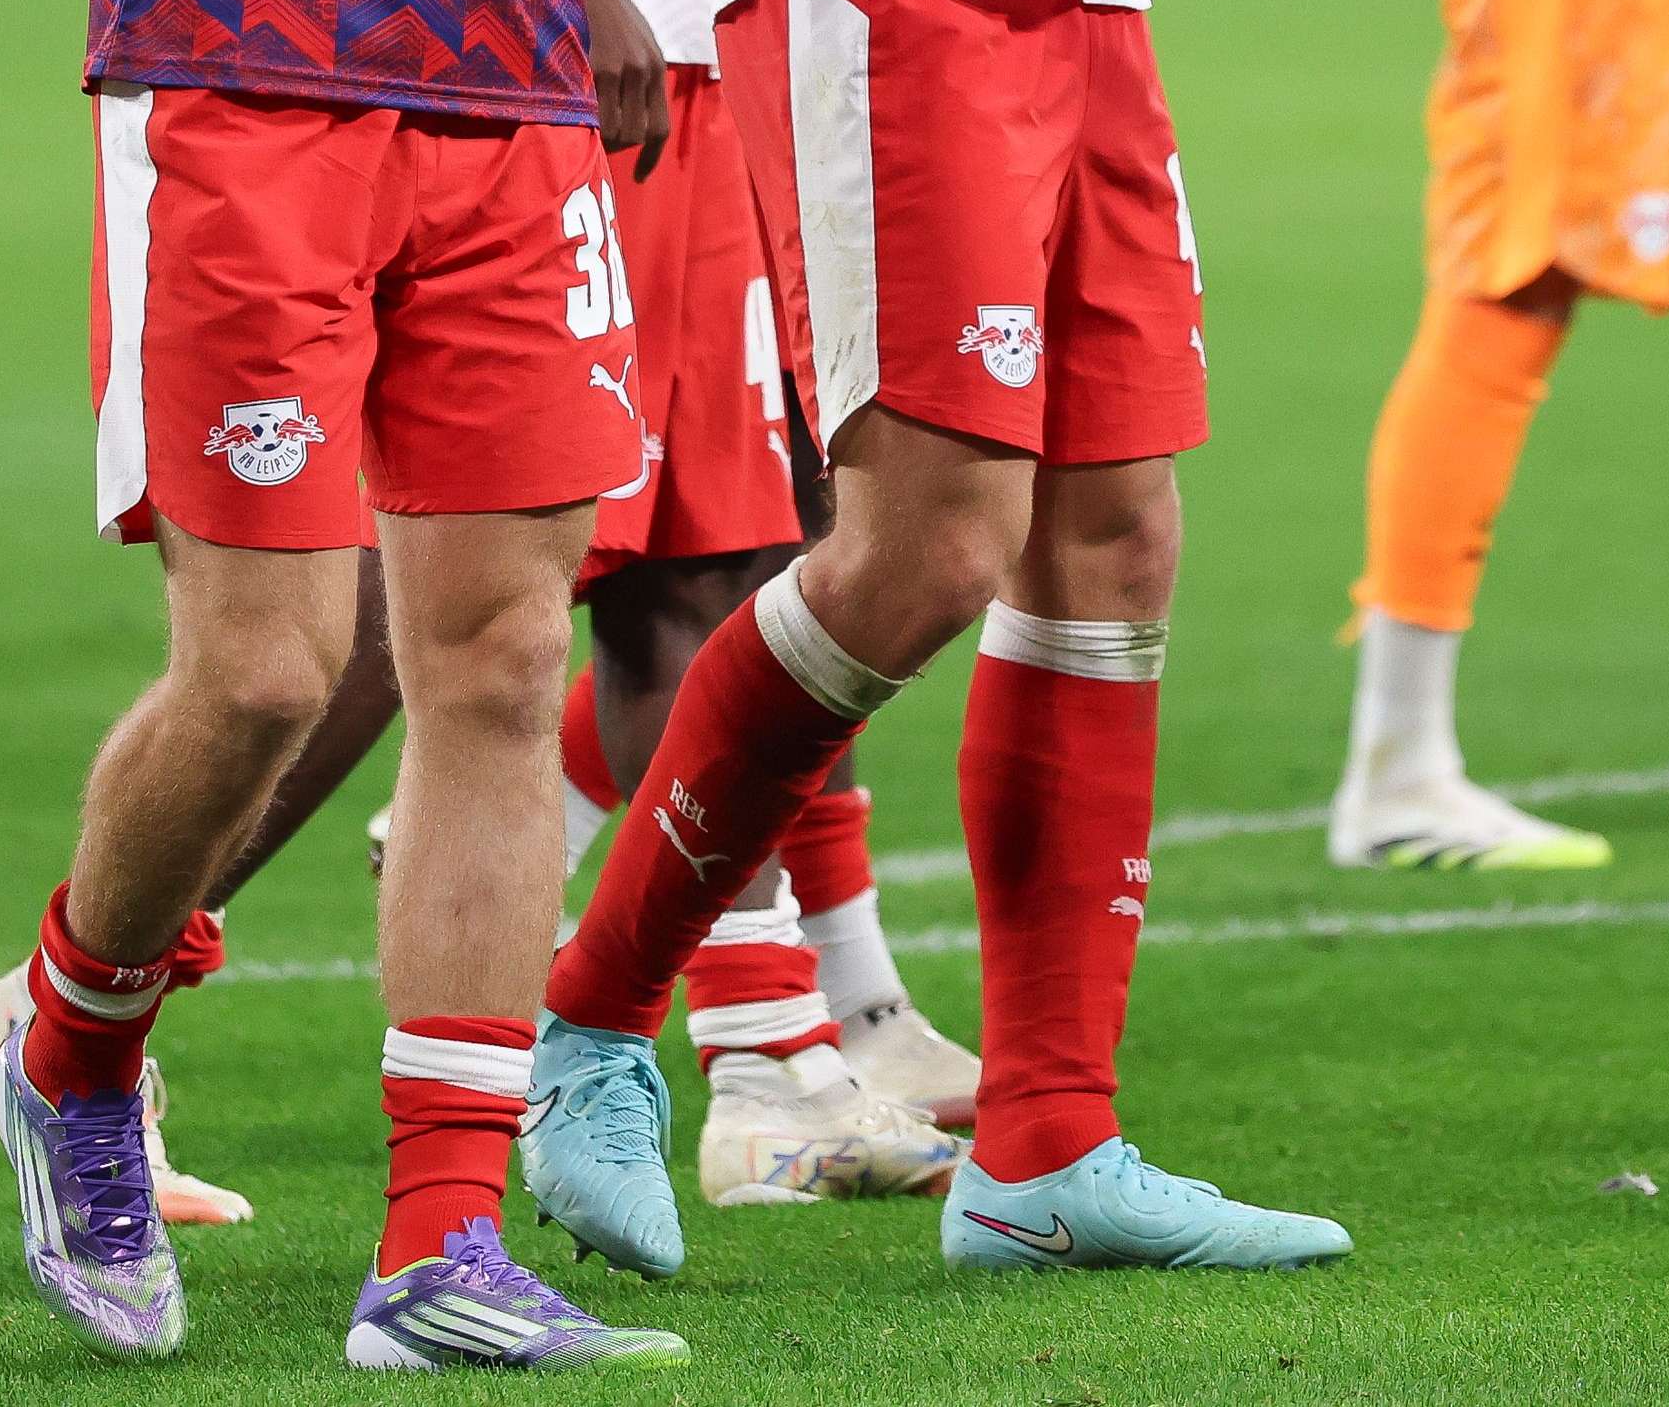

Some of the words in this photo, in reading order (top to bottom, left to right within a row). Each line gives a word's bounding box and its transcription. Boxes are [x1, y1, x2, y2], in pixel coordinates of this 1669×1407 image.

[238, 452, 255, 469] RB
[256, 446, 299, 474] LEIPZIG
[669, 777, 709, 833] RBL
